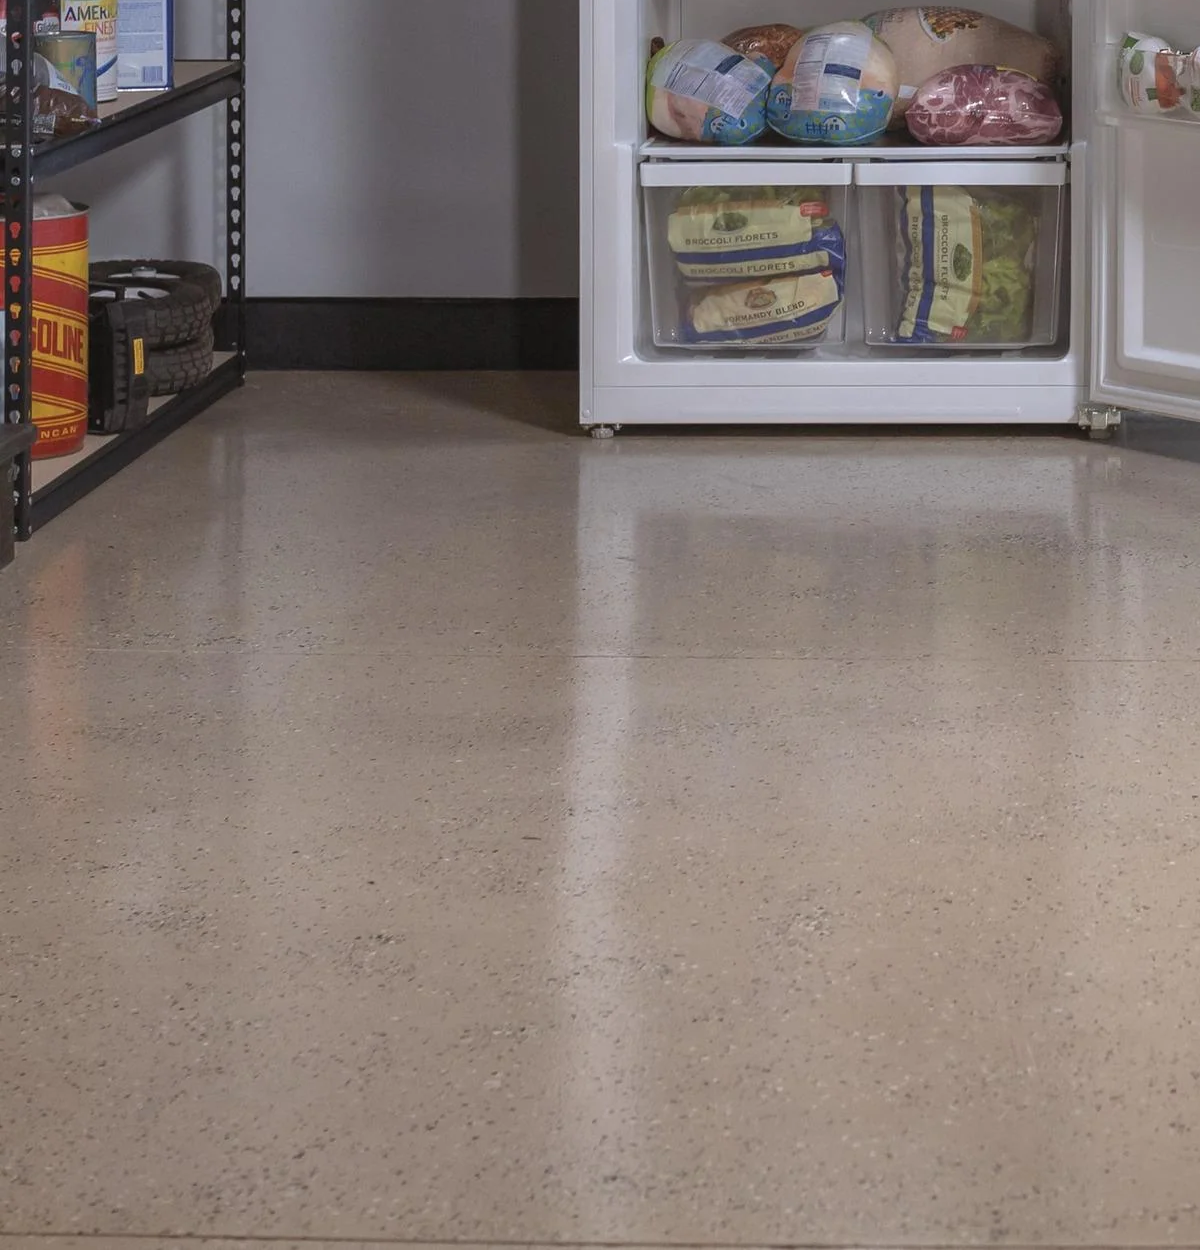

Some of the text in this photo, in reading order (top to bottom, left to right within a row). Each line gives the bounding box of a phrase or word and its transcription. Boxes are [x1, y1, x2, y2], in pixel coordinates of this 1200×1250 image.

[685, 231, 779, 246] BROCCOLI FLORETS
[690, 261, 796, 275] BROCCOLI FLORETS
[775, 300, 805, 316] BLEND
